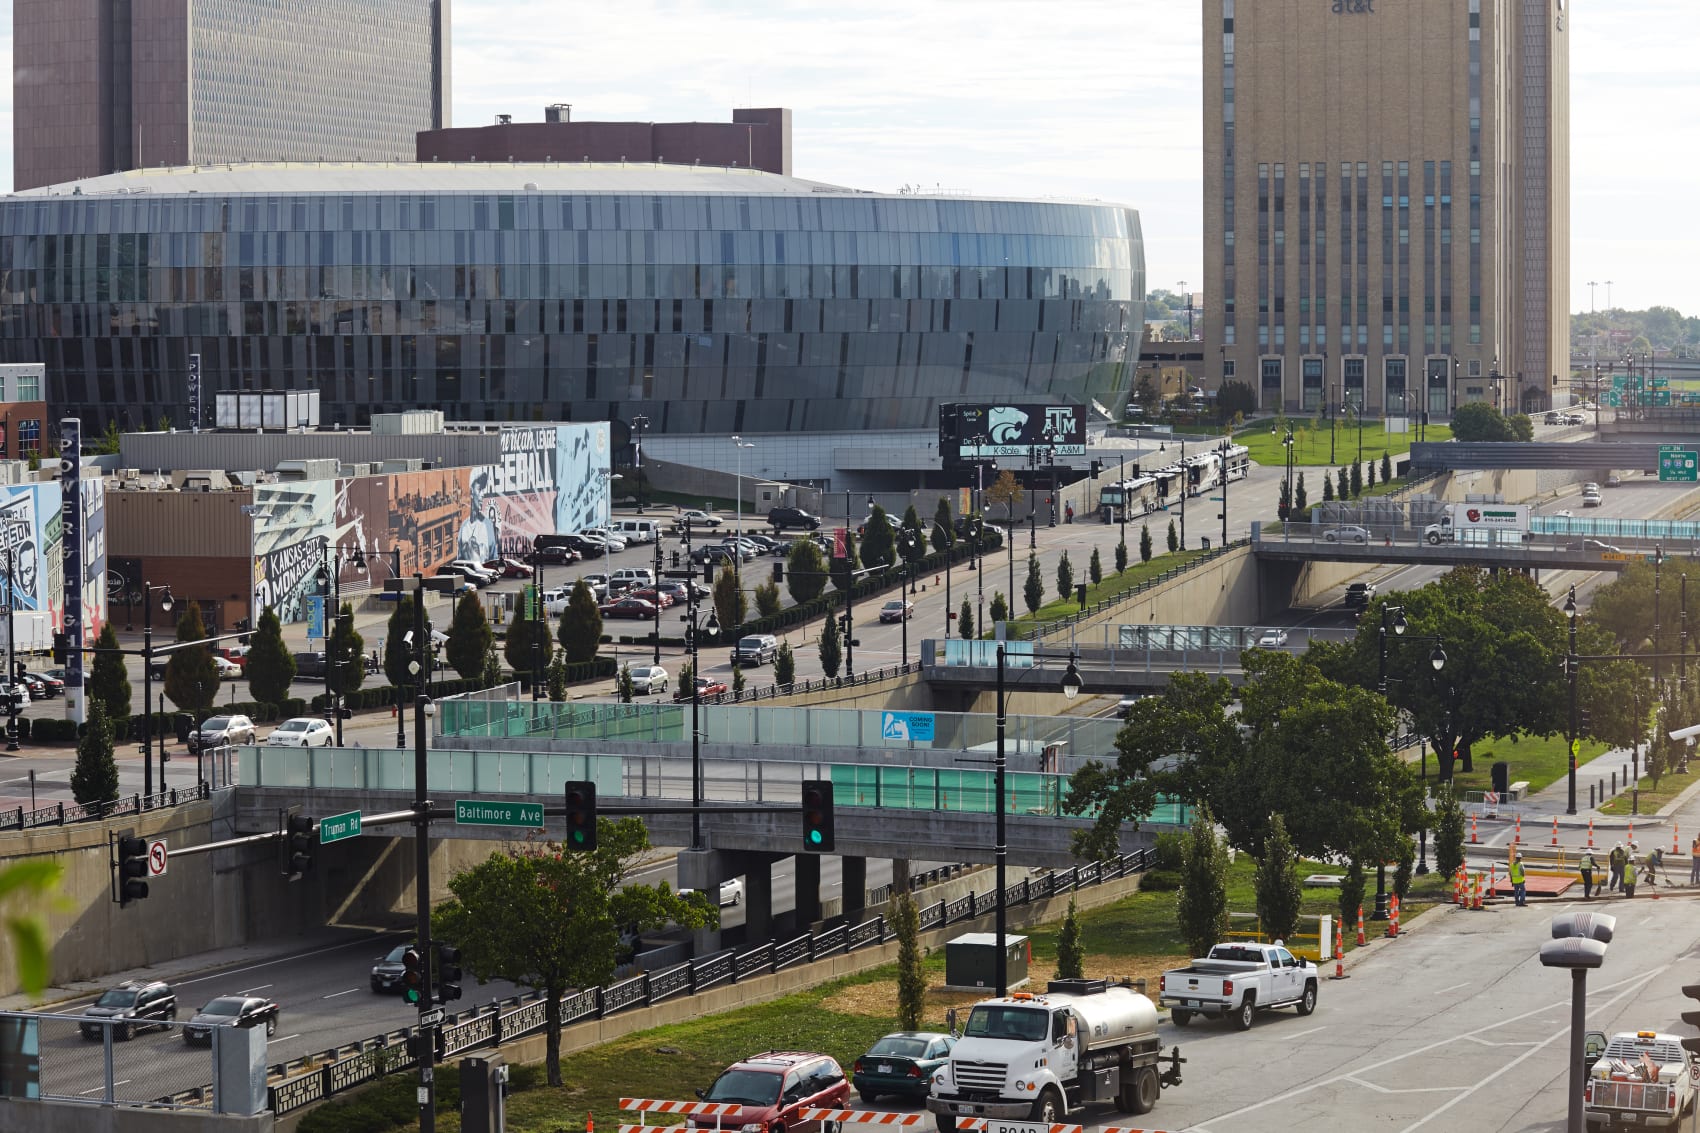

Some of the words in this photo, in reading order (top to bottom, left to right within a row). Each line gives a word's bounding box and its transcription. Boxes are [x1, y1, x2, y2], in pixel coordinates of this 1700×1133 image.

[188, 363, 197, 413] POWER
[482, 450, 553, 494] ASEBALL
[1061, 446, 1080, 456] A&M
[58, 439, 74, 535] POWER
[270, 537, 321, 578] KANSAS-CITY
[272, 548, 322, 605] MONARCHS
[325, 823, 346, 837] Truman
[350, 818, 358, 830] Rd
[459, 806, 511, 820] Baltimore
[520, 808, 540, 821] Ave
